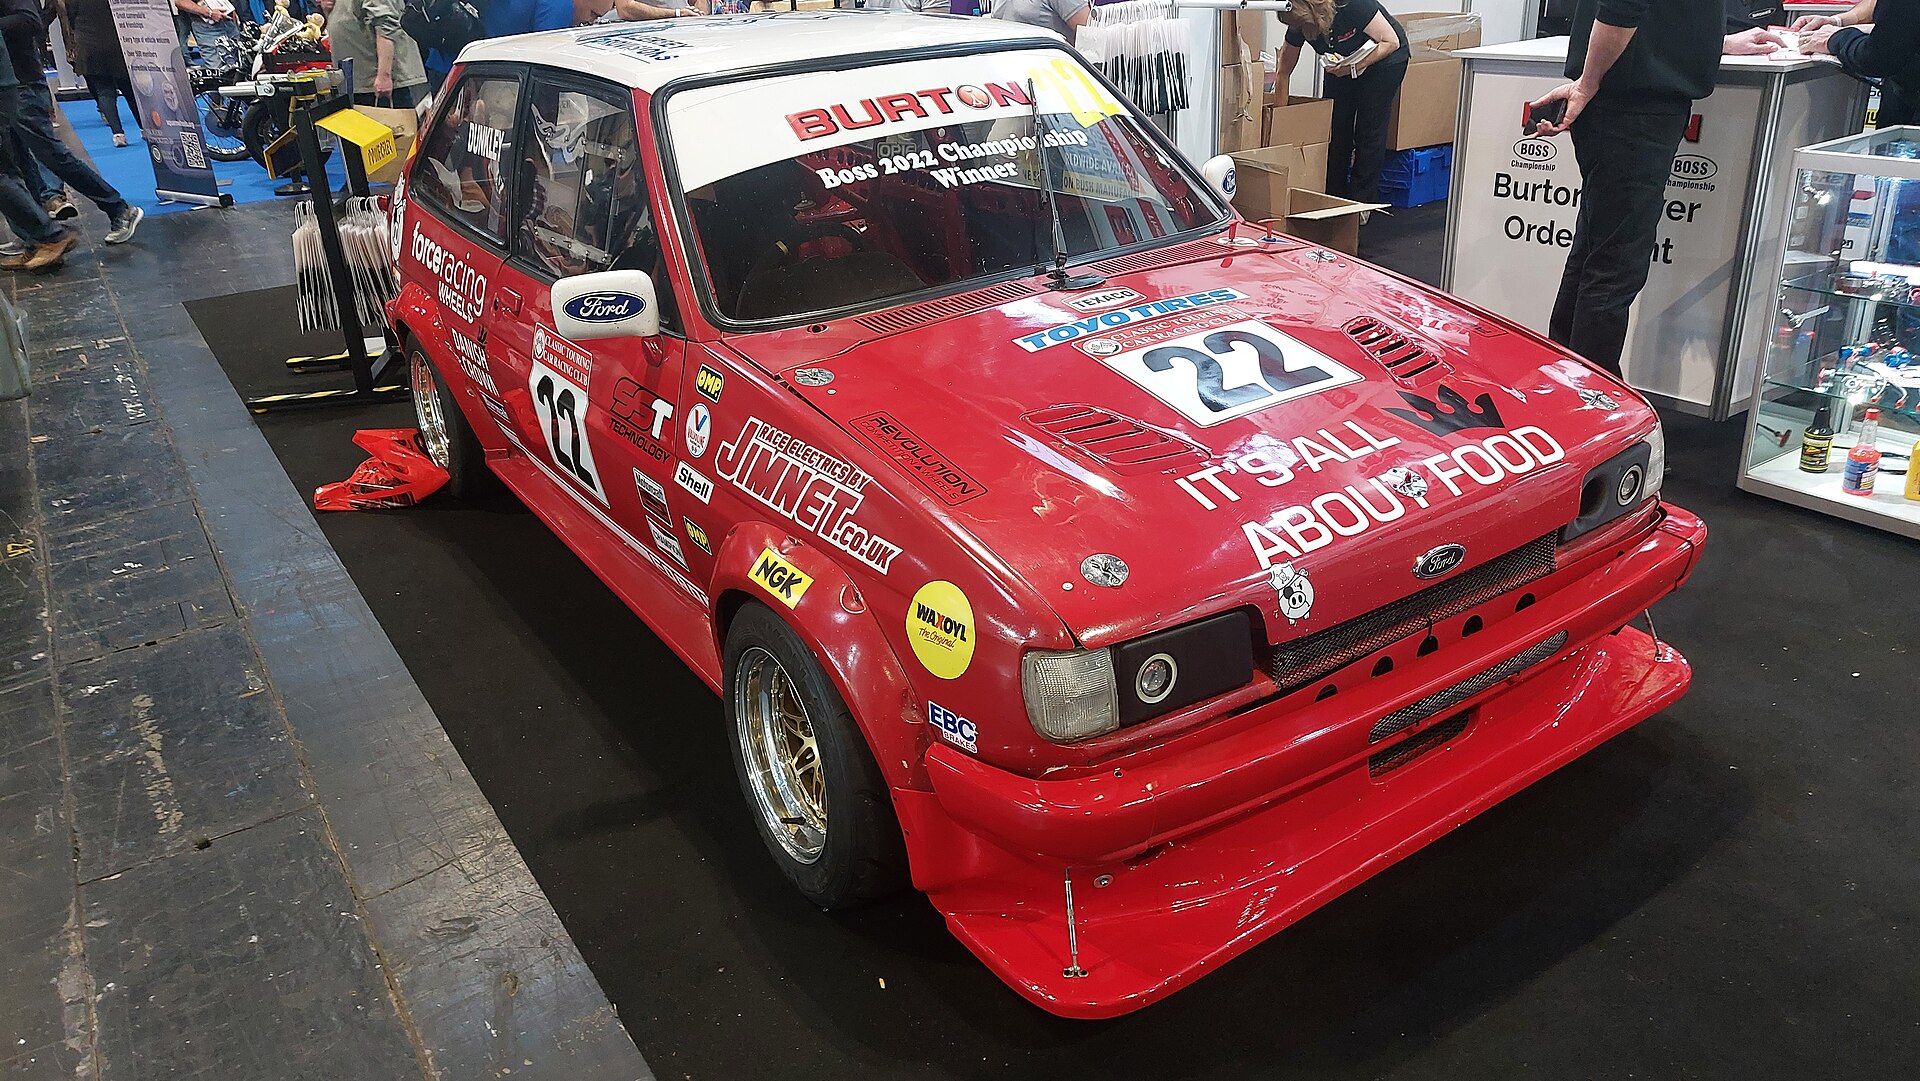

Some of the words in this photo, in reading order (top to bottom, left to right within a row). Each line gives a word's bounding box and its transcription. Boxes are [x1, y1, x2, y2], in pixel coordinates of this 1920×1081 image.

[785, 81, 1034, 141] BURTON
[467, 121, 505, 162] DUNKLEY
[1520, 143, 1549, 158] BOSS
[816, 163, 879, 189] Boss
[879, 150, 939, 175] 2022
[930, 160, 1018, 189] Winner
[1511, 159, 1556, 172] Championship
[1665, 179, 1716, 192] hampionship
[1674, 160, 1709, 176] BOSS
[1504, 215, 1573, 248] Orde
[411, 221, 487, 317] forceracing
[438, 281, 474, 324] WHEELS
[580, 296, 630, 317] Ford
[1023, 311, 1131, 349] TOYO
[1128, 289, 1237, 318] TIRES
[1072, 290, 1135, 308] TEXACO
[1110, 319, 1174, 342] CLASSIC
[1174, 306, 1234, 329] TOURING
[1122, 334, 1154, 349] CAR
[1154, 323, 1205, 343] RACING
[1205, 313, 1249, 331] CLUB
[451, 327, 489, 371] DANISH
[543, 349, 554, 366] CAR
[553, 357, 573, 378] RACING
[573, 366, 588, 385] CLUB
[545, 335, 565, 355] CLASSIC
[565, 346, 589, 370] TOURING
[1143, 331, 1333, 412] 22
[610, 377, 674, 441] SST
[537, 375, 598, 493] 22
[609, 418, 670, 464] TECHNOLOGY
[760, 424, 787, 449] RACE
[788, 439, 849, 482] ELECTRICS
[851, 467, 869, 489] BY
[860, 421, 919, 465] COMPETITION
[921, 469, 959, 499] WHEELS
[870, 417, 975, 494] REVOLUTION
[1174, 450, 1296, 511] IT'S
[1290, 420, 1402, 473] ALL
[1422, 425, 1567, 498] FOOD
[679, 467, 710, 500] Shell
[755, 556, 803, 600] NGK
[1429, 550, 1456, 573] Ford
[916, 602, 967, 643] WAXOYL
[918, 626, 931, 639] The
[929, 630, 956, 649] Original
[930, 702, 976, 742] EBC
[943, 730, 978, 752] BRAKES
